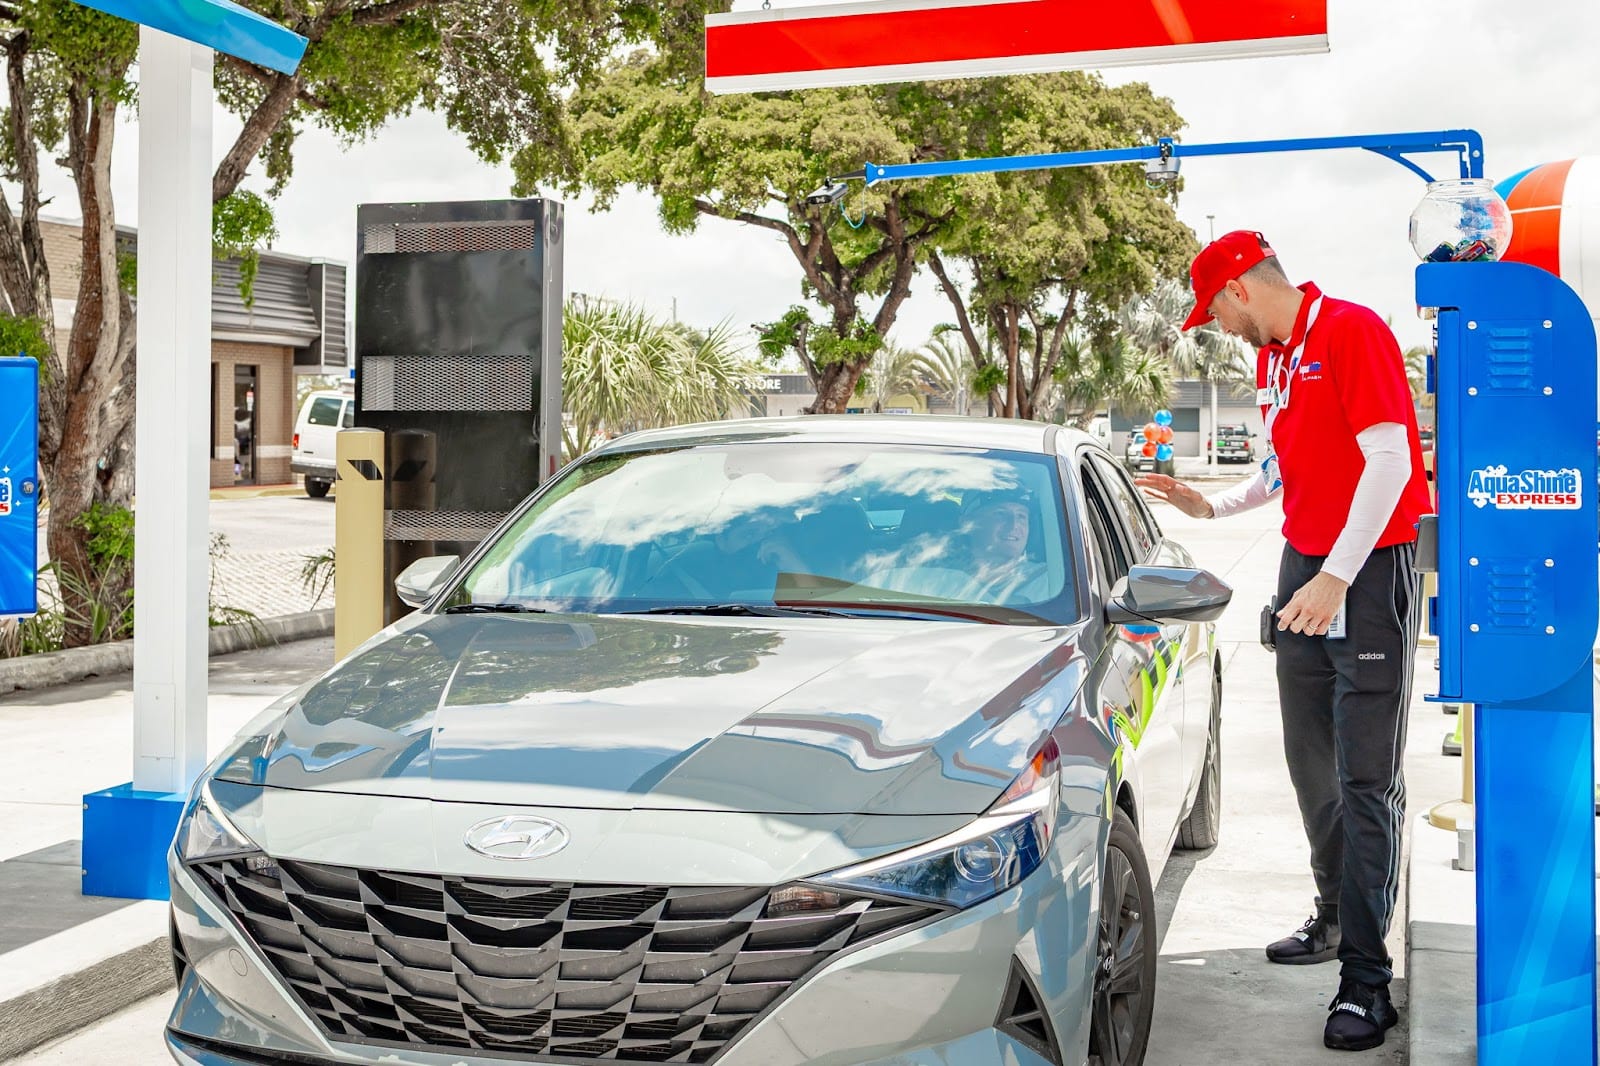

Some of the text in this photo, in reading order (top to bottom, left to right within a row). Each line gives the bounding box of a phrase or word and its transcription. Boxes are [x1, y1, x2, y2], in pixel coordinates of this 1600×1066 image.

[1469, 471, 1577, 498] AquaShine
[1497, 494, 1576, 504] EXPRESS
[1358, 652, 1385, 660] adidas
